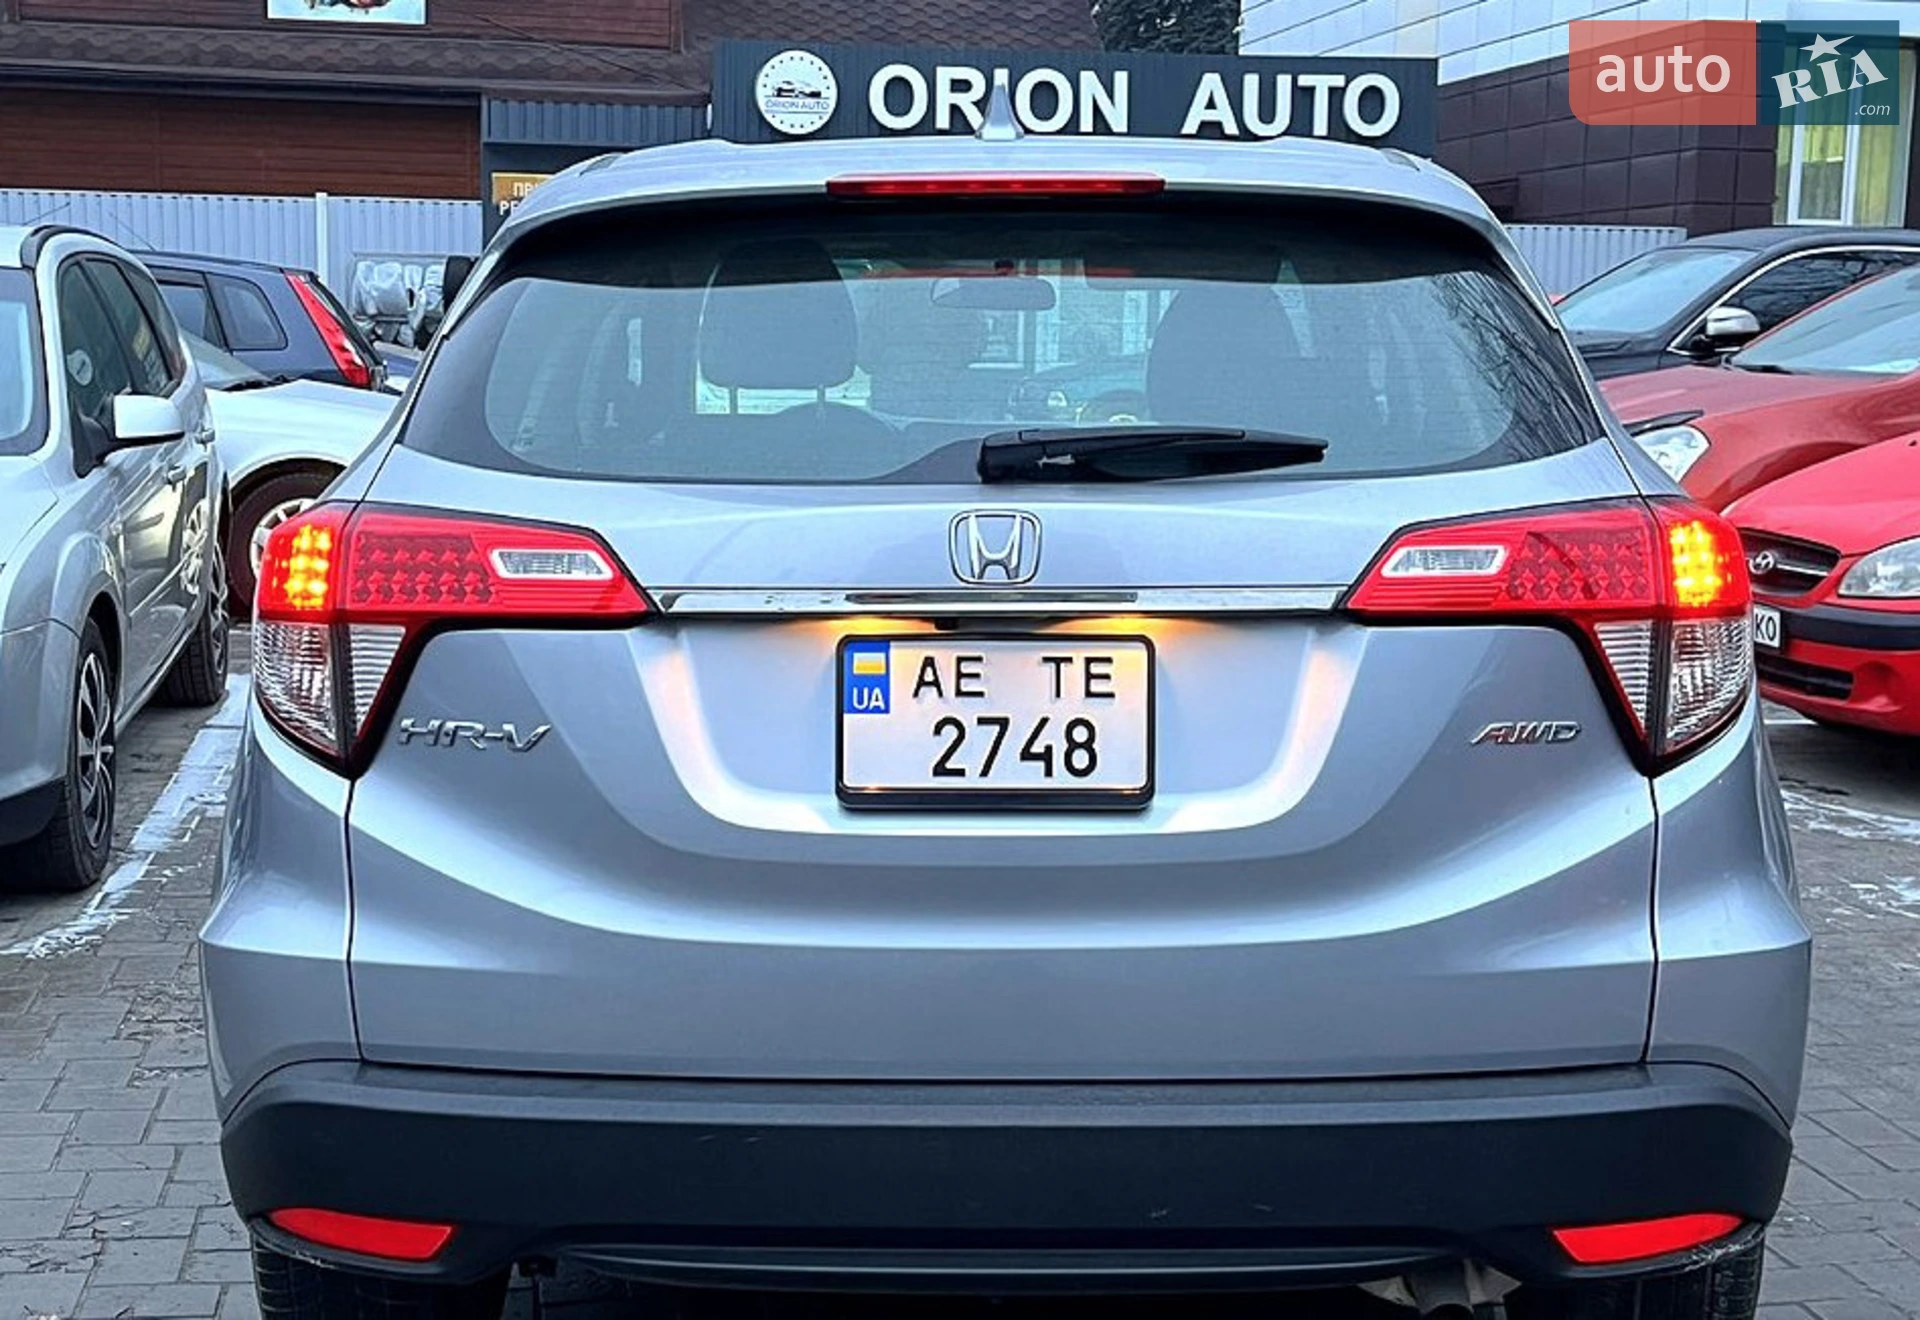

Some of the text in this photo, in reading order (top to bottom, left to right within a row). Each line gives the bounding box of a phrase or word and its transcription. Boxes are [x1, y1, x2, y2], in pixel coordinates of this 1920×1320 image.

[800, 101, 830, 110] AUTO
[1180, 72, 1400, 138] AUTO
[912, 655, 1116, 699] AE TE
[852, 687, 885, 710] UA
[399, 718, 551, 751] HR-V
[932, 716, 1098, 778] 2748
[1470, 720, 1581, 746] AWD
